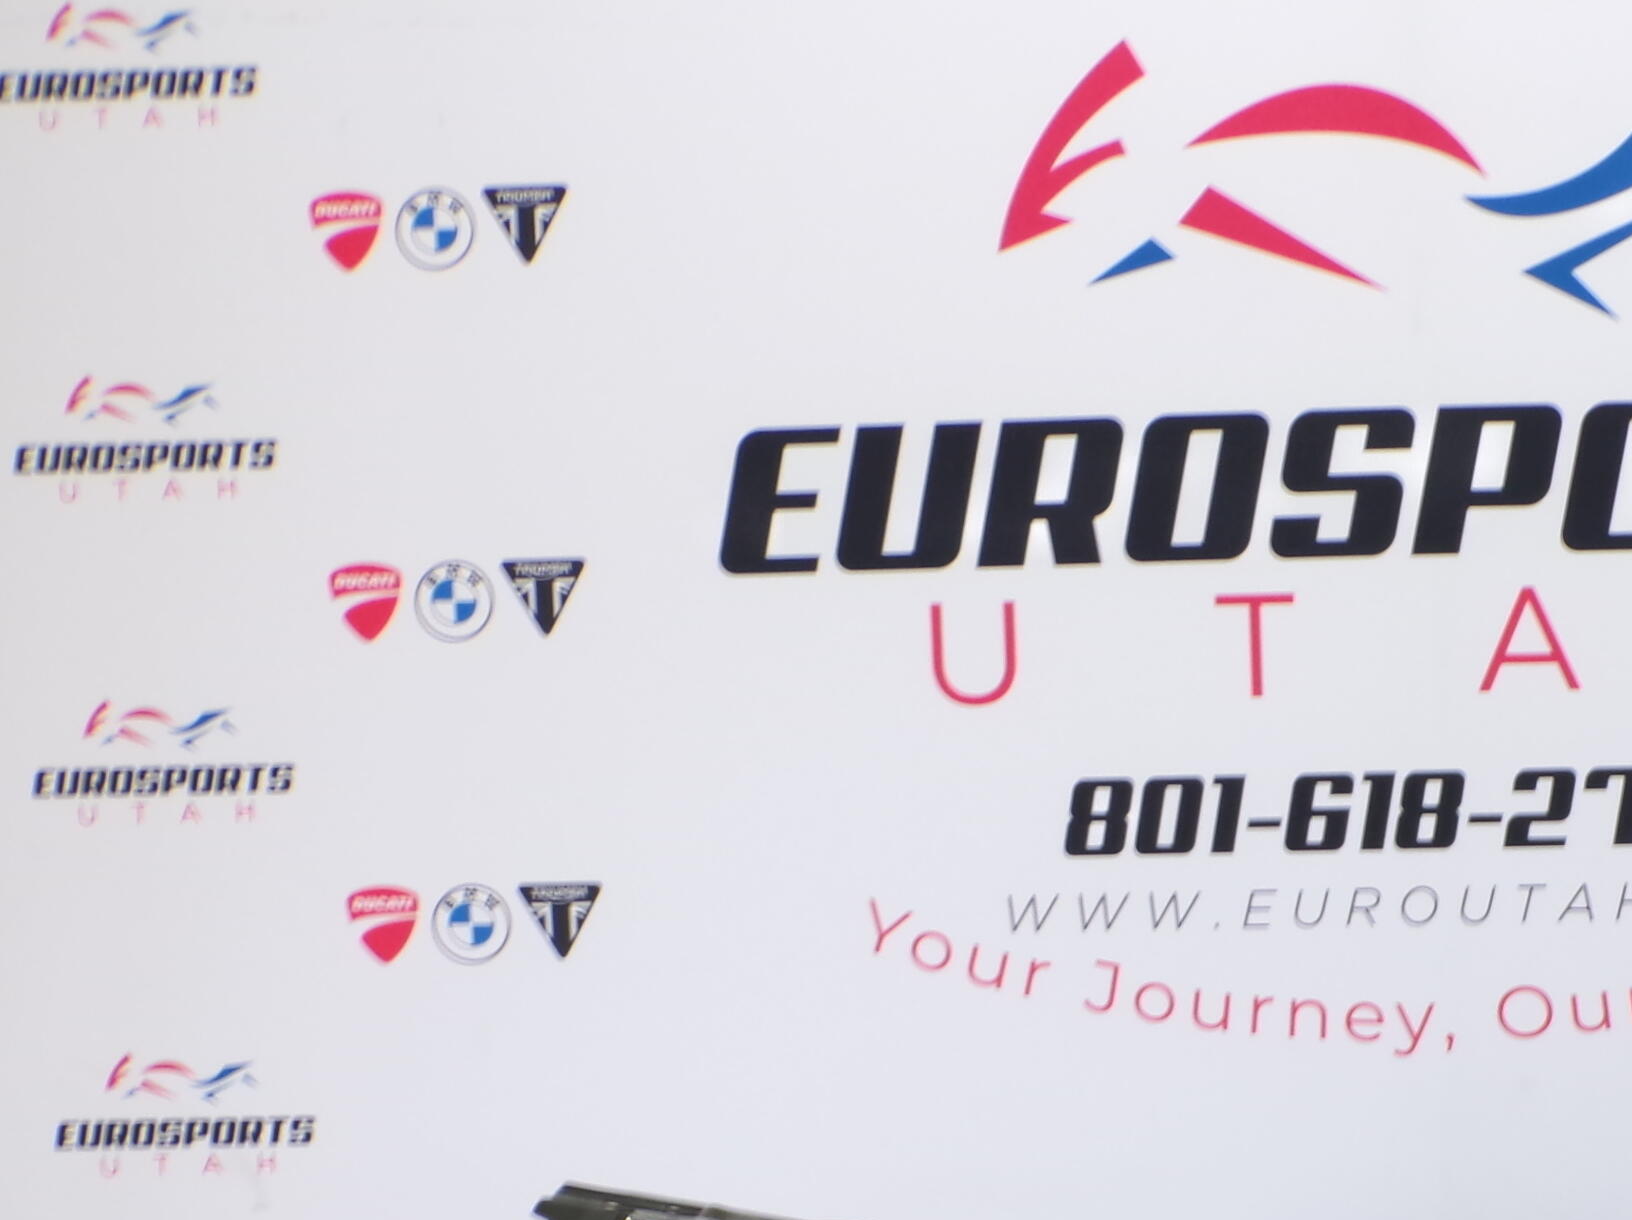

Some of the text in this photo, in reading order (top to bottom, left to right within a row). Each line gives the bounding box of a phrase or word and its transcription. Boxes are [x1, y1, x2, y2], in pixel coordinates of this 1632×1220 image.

[14, 440, 276, 473] EUROSPORTS
[32, 764, 295, 797] EUROSPORTS
[868, 896, 1052, 998] Your
[1083, 957, 1457, 1058] Journey,
[55, 1117, 316, 1150] EUROSPORTS
